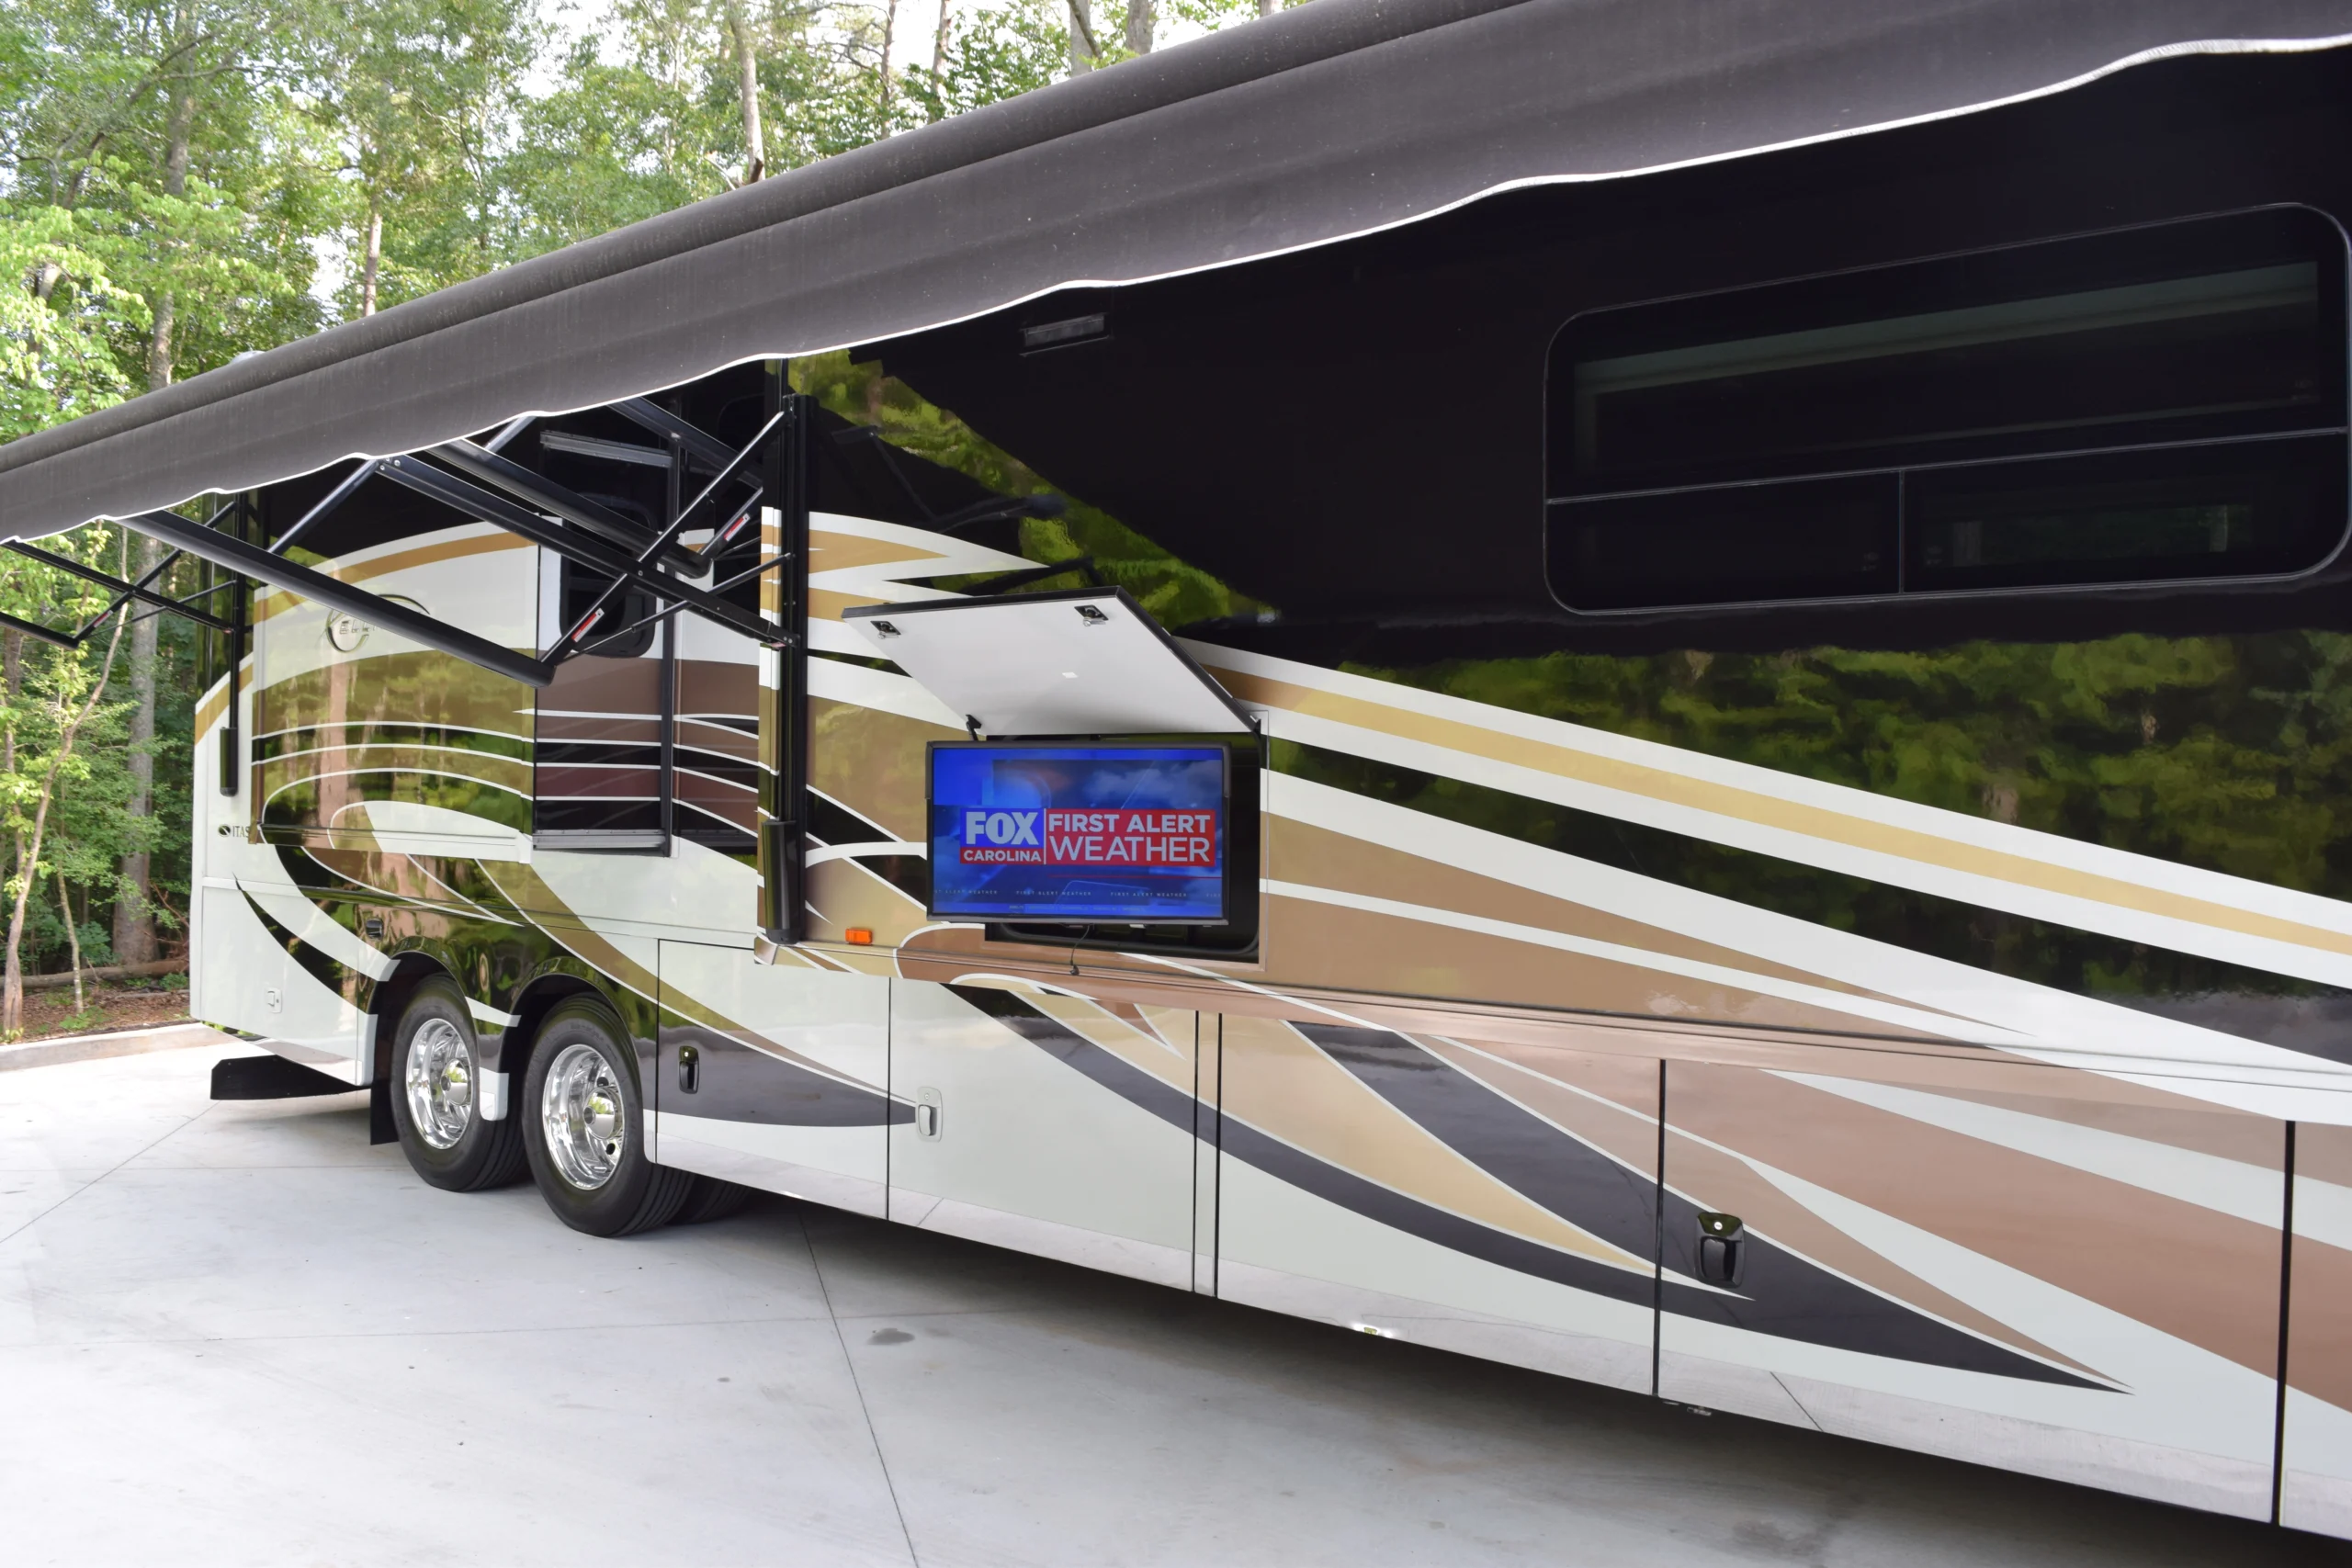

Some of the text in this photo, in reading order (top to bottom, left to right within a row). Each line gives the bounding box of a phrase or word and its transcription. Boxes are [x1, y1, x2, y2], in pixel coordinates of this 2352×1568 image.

[966, 811, 1039, 845] FOX
[1048, 814, 1211, 833] FIRST ALERT
[963, 850, 1042, 863] CAROLINA
[1048, 836, 1211, 863] WEATHER
